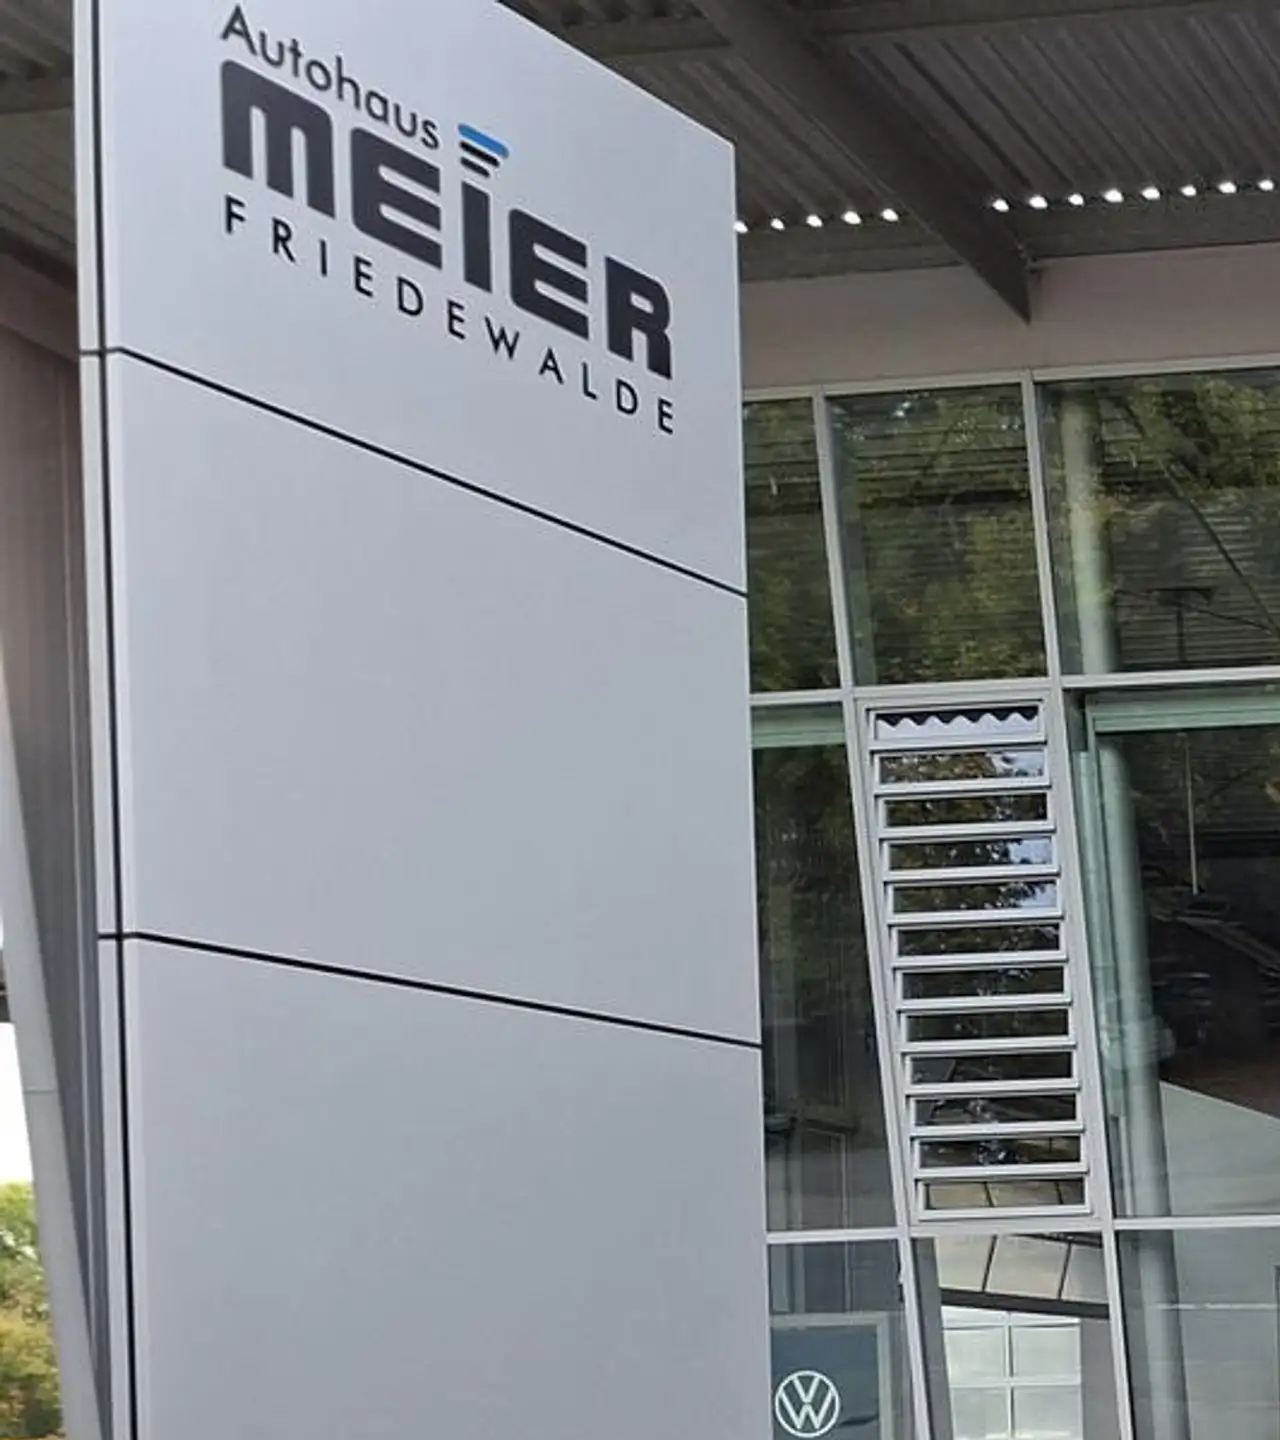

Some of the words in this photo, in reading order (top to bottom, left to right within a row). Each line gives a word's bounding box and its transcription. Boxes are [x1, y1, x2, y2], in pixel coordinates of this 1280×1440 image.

[220, 4, 440, 151] Autohaus
[220, 59, 673, 381] MEIER
[224, 194, 675, 435] FRIEDEWALDE
